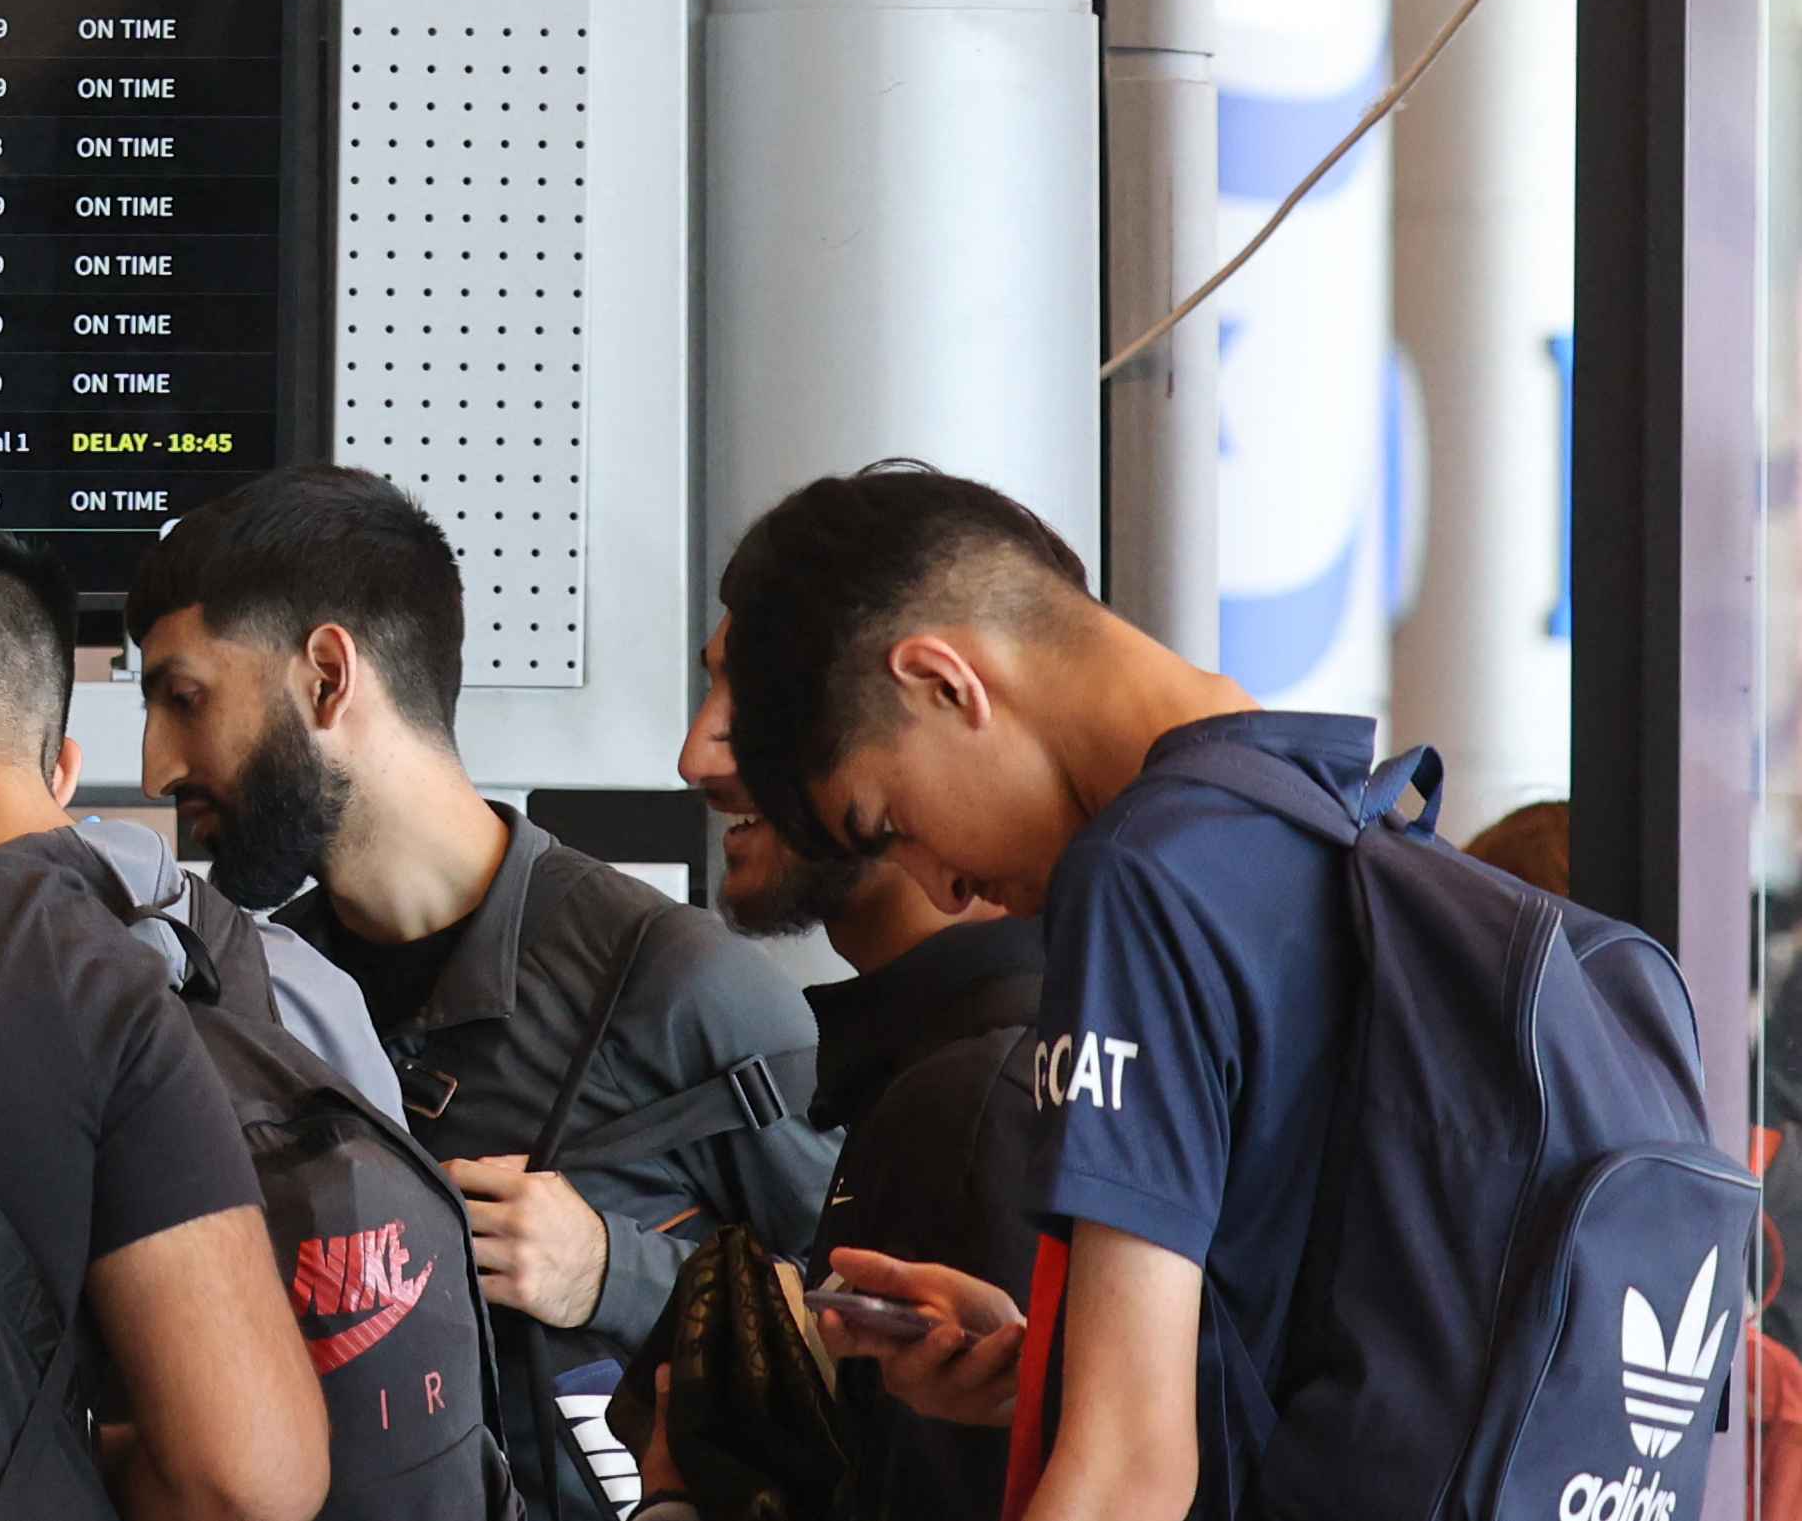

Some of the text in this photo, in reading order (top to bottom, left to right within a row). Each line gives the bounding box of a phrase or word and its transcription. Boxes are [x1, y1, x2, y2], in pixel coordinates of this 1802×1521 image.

[76, 137, 112, 158] ON
[117, 137, 175, 158] TIME
[16, 432, 30, 452] 1
[72, 432, 149, 453] DELAY
[167, 433, 233, 453] 18:45
[293, 1221, 416, 1317] NIKE
